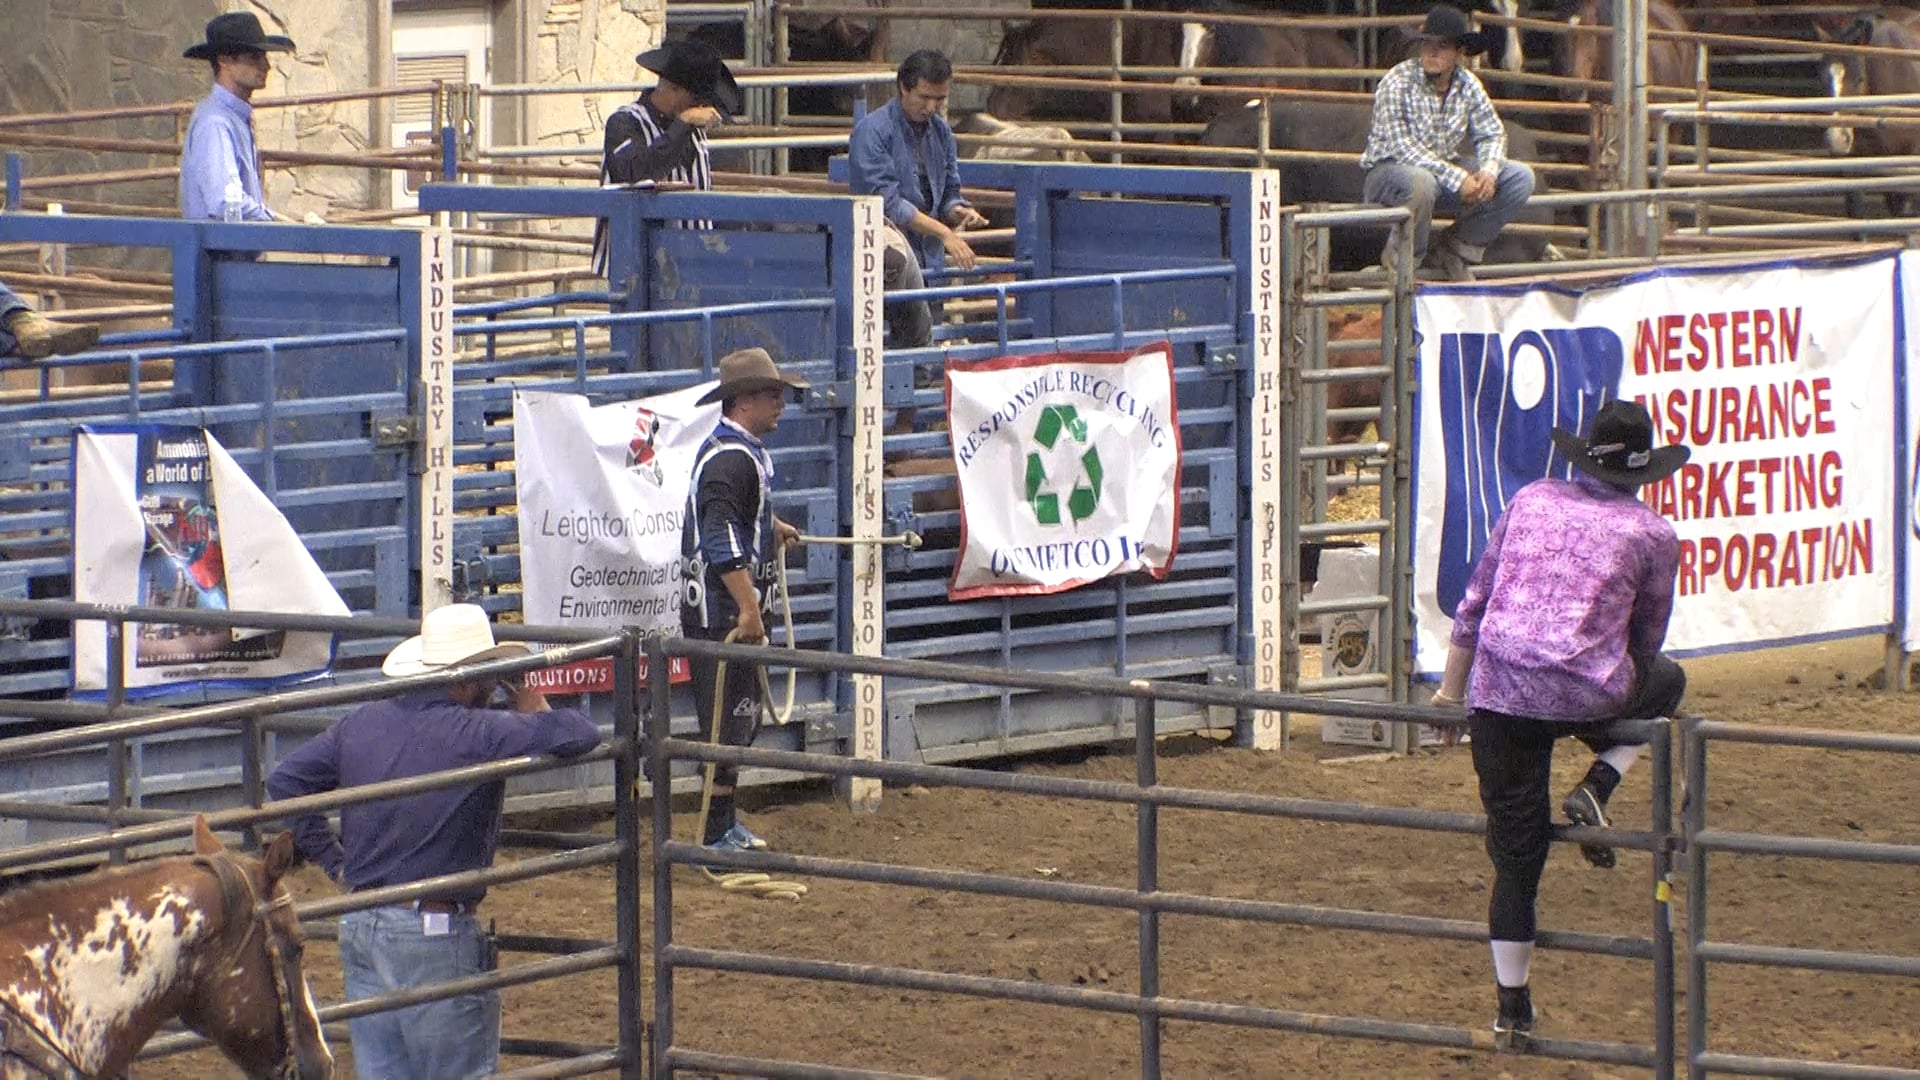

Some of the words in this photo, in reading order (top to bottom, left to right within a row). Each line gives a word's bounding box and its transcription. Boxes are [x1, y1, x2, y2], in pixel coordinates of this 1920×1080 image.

[862, 205, 876, 391] INDUSTRY
[1259, 178, 1272, 356] INDUSTRY
[430, 236, 444, 430] INDUSTRY
[1633, 307, 1802, 376] WESTERN
[1070, 371, 1166, 448] RECYCLING
[1260, 371, 1272, 482] HILLS
[1634, 377, 1836, 446] NSURANCE
[146, 467, 154, 484] a
[155, 463, 187, 482] World
[191, 462, 203, 481] of
[157, 439, 208, 458] Ammonia
[863, 406, 876, 520] HILLS
[431, 447, 445, 566] HILLS
[541, 509, 633, 544] Leighton
[633, 508, 684, 536] Consu
[570, 563, 668, 588] Geotechnical
[1261, 539, 1273, 604] PRO
[1679, 517, 1874, 597] RPORATION
[559, 593, 669, 618] Environmental
[862, 578, 875, 644] PRO
[524, 667, 607, 689] SOLUTIONS
[1262, 619, 1274, 730] RODO
